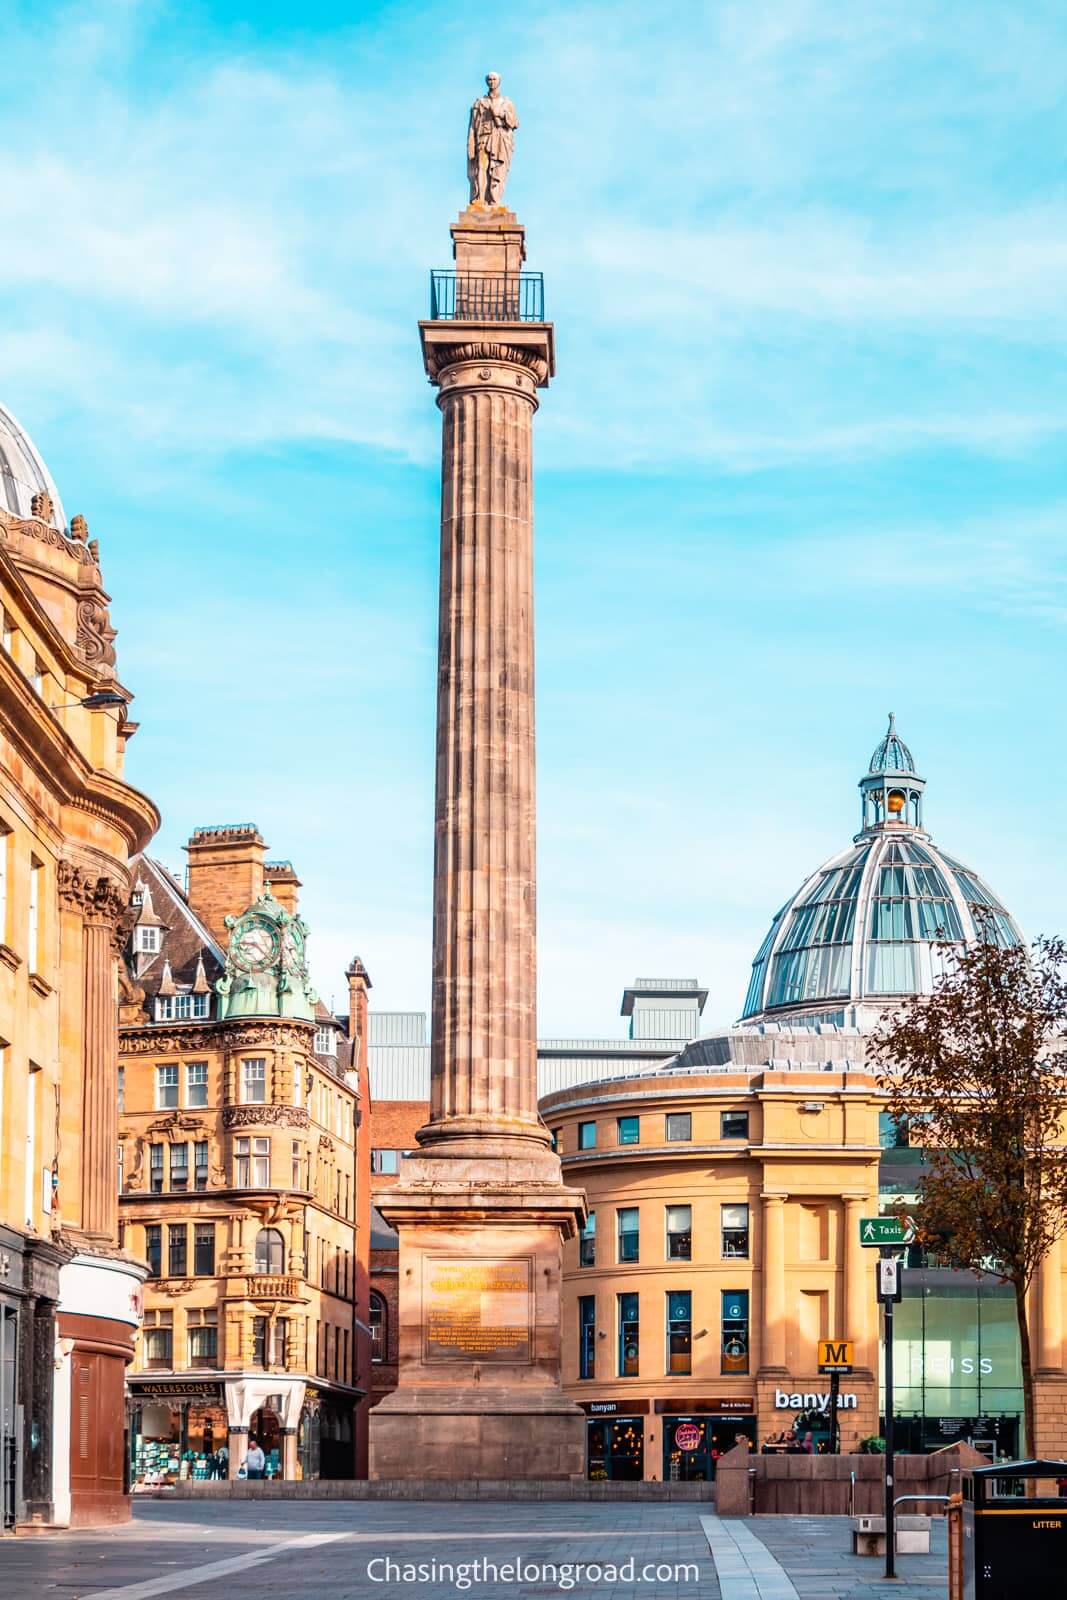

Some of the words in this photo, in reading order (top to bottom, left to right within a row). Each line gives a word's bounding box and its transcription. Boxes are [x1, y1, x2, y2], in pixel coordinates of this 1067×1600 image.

[879, 1226, 902, 1234] Taxis
[824, 1344, 848, 1363] M
[911, 1358, 993, 1374] REISS
[143, 1383, 216, 1393] WATERSTONES
[591, 1403, 617, 1413] banyan
[1032, 1520, 1062, 1529] LITTER
